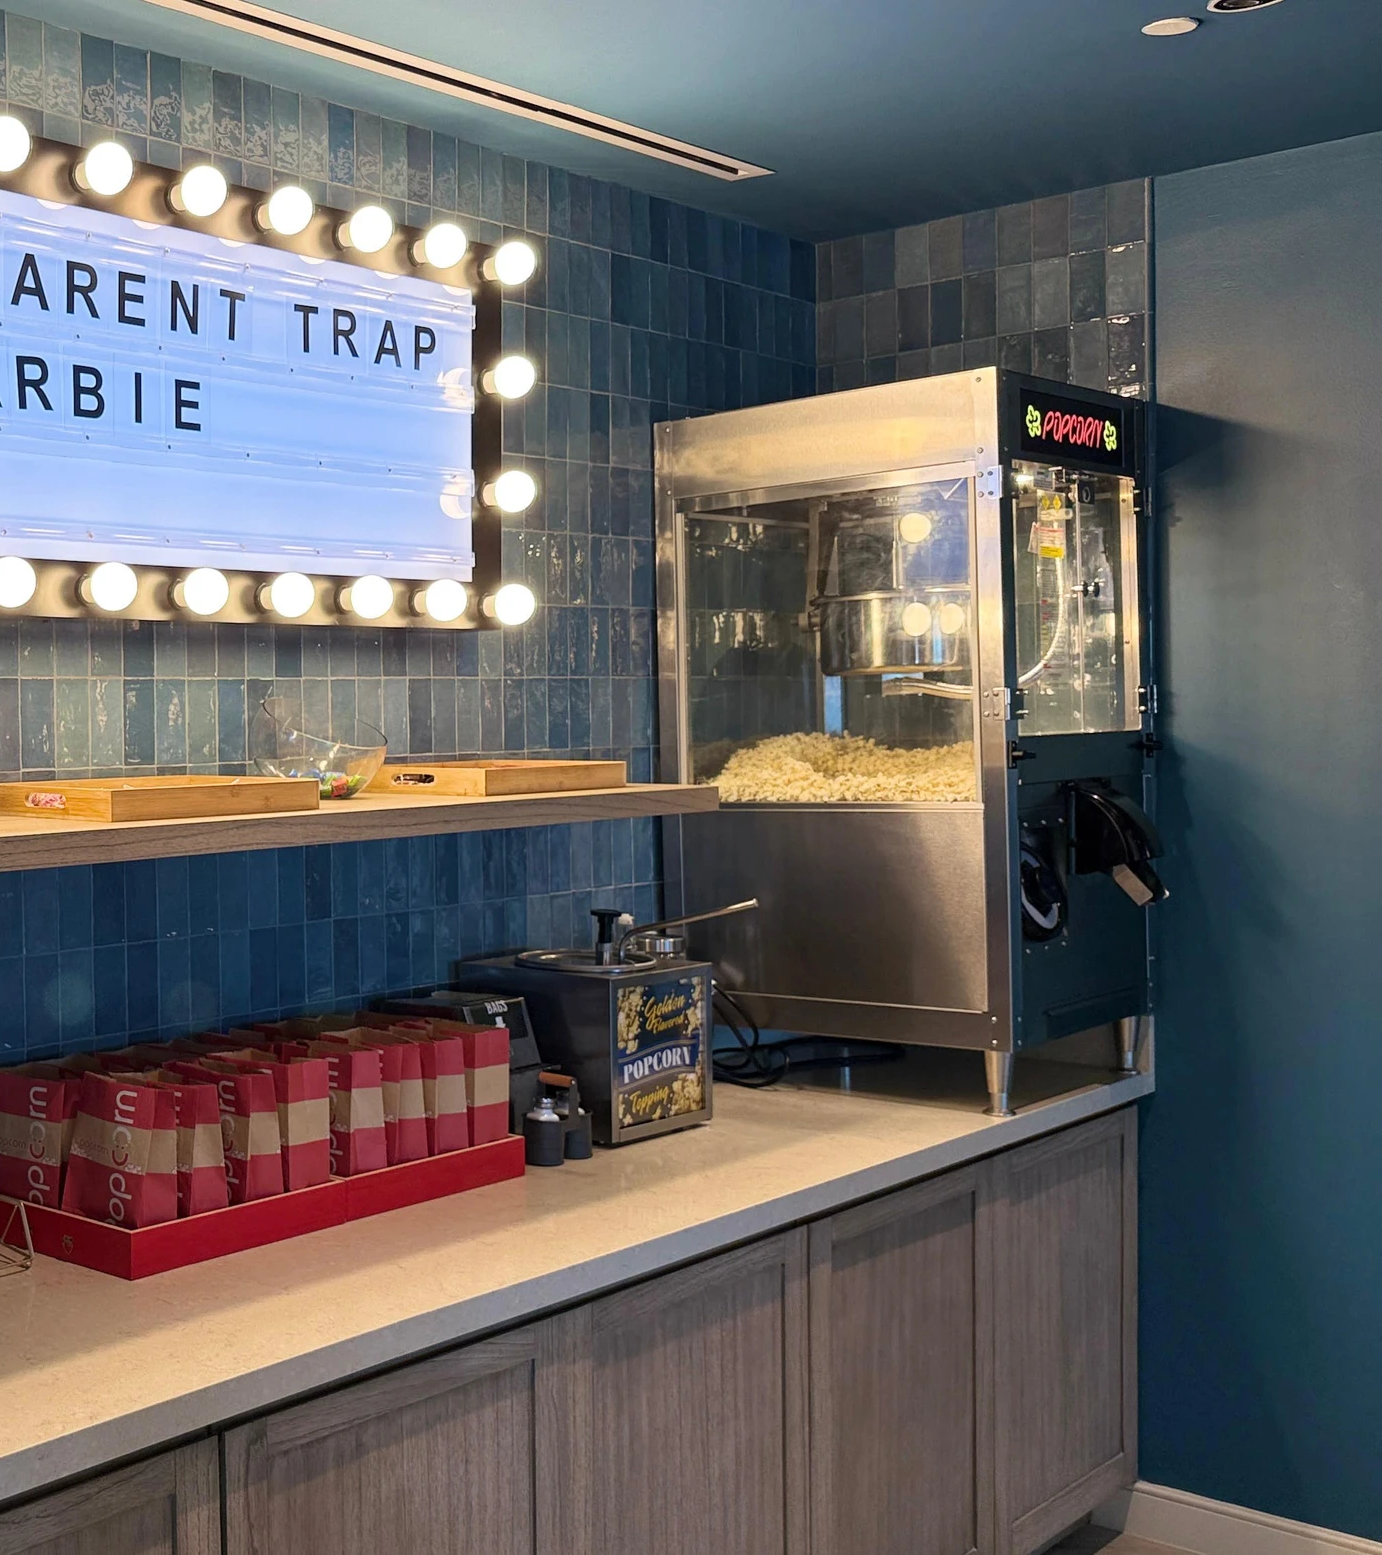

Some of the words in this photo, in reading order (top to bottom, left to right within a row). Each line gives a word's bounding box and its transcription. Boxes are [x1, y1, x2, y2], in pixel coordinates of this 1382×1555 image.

[293, 303, 437, 371] TRAP
[1042, 410, 1104, 448] POPCORN
[484, 999, 508, 1015] BAGS
[644, 992, 686, 1030] Golden
[652, 1011, 685, 1034] Flavored
[623, 1045, 692, 1084] POPCORN
[629, 1084, 670, 1116] Topping
[27, 1085, 51, 1205] opcorn
